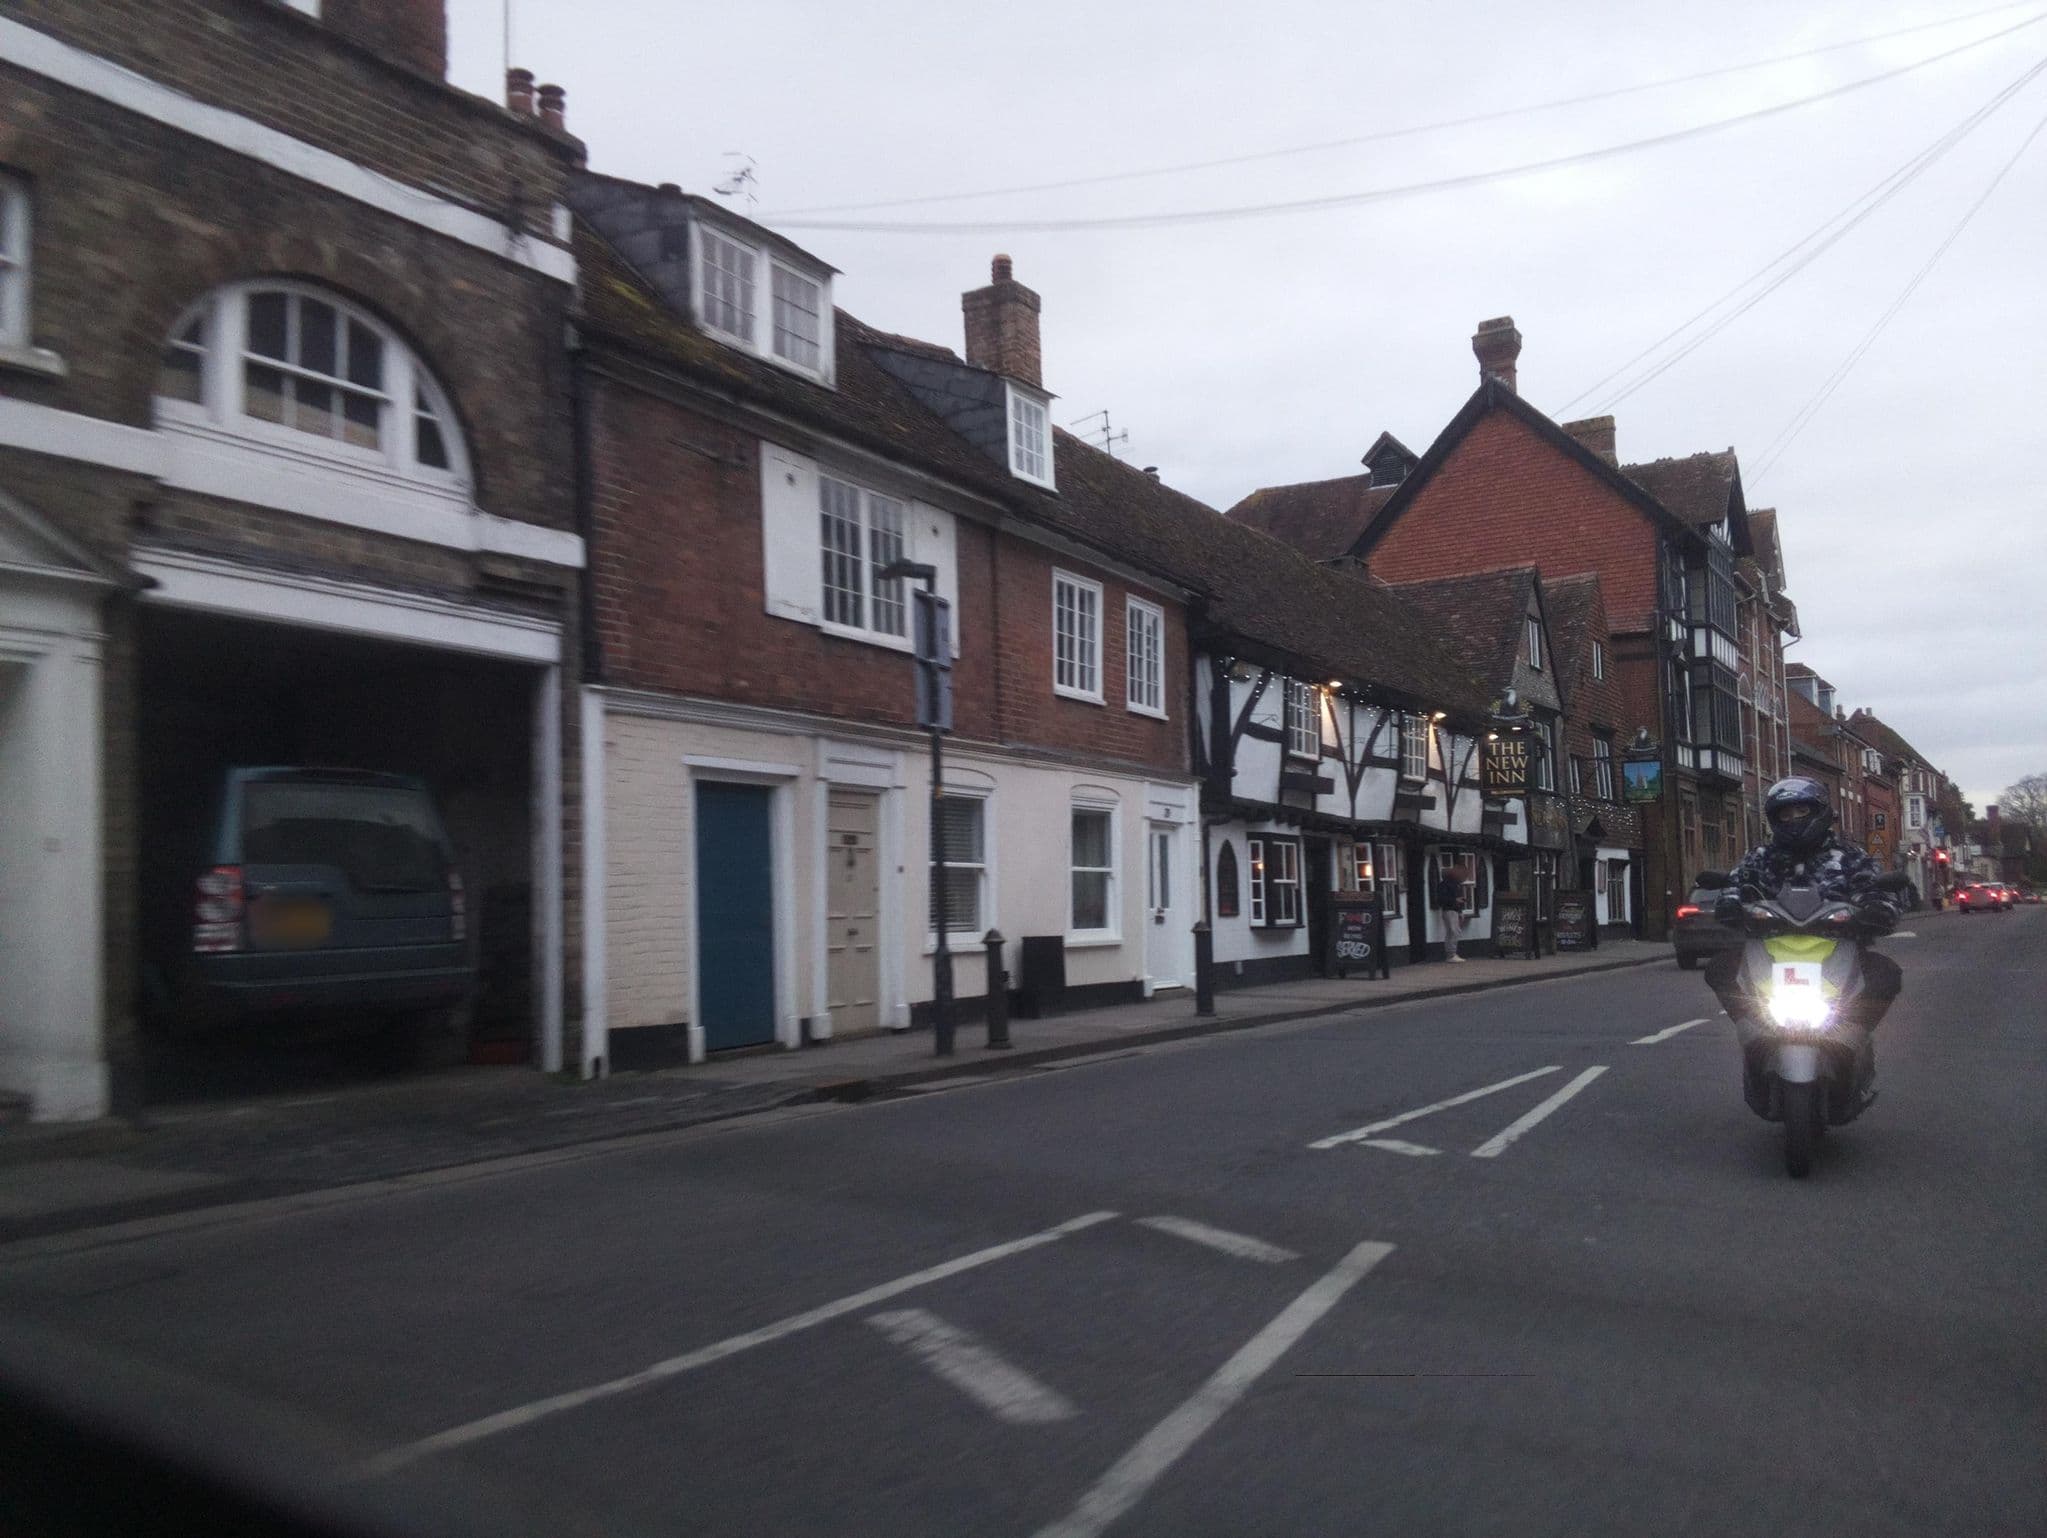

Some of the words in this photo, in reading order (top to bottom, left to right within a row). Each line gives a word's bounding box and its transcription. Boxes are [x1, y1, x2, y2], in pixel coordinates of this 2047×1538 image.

[1488, 741, 1525, 755] THE
[1486, 755, 1528, 770] NEW
[1489, 770, 1525, 784] INN
[1784, 967, 1809, 985] L
